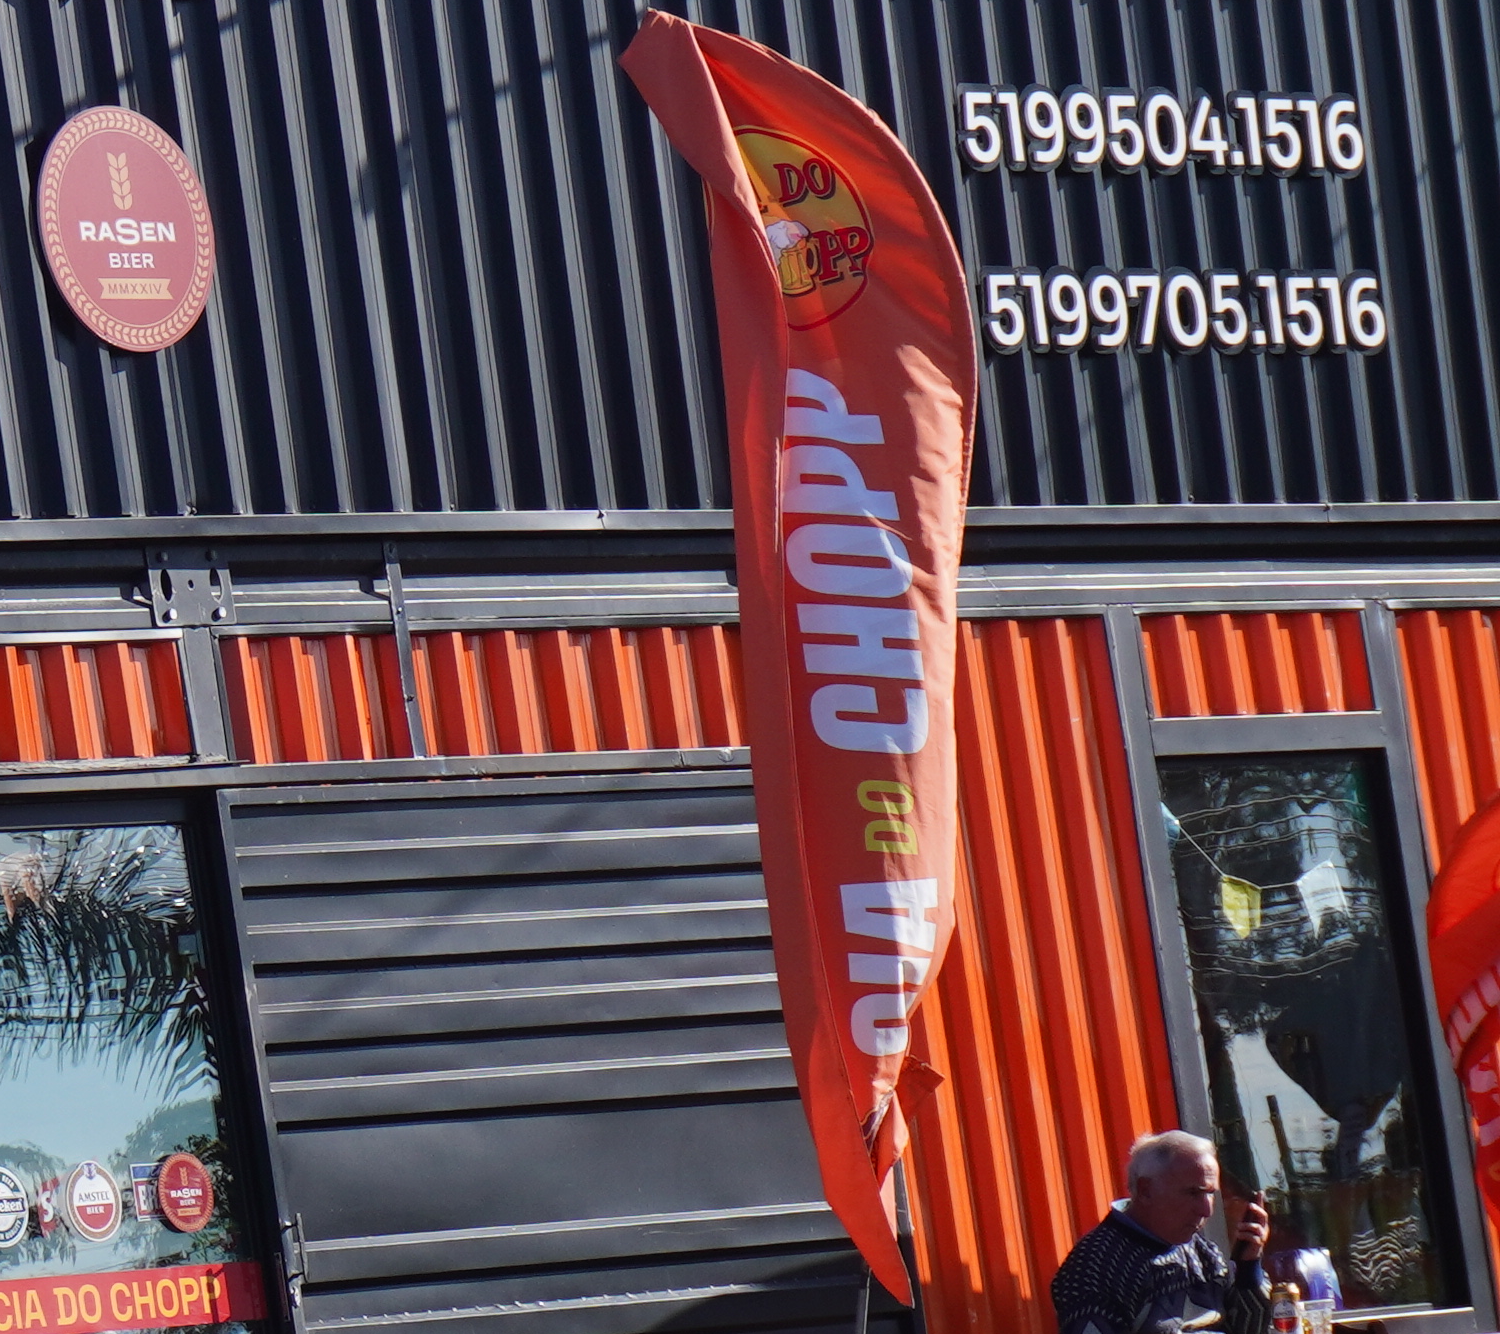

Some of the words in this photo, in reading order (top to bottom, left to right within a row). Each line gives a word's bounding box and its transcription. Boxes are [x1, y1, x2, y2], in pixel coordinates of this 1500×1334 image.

[959, 88, 1366, 171] 5199504.1516
[774, 157, 836, 207] DO
[78, 218, 177, 246] RASEN
[108, 251, 156, 269] BIER
[107, 282, 163, 296] MMXXIV
[984, 271, 1388, 351] 5199705.1516
[782, 367, 931, 755] CHOPP
[857, 779, 920, 857] DO
[78, 1191, 110, 1203] AMSTEL
[52, 1282, 102, 1327] DO
[109, 1275, 223, 1323] CHOPP
